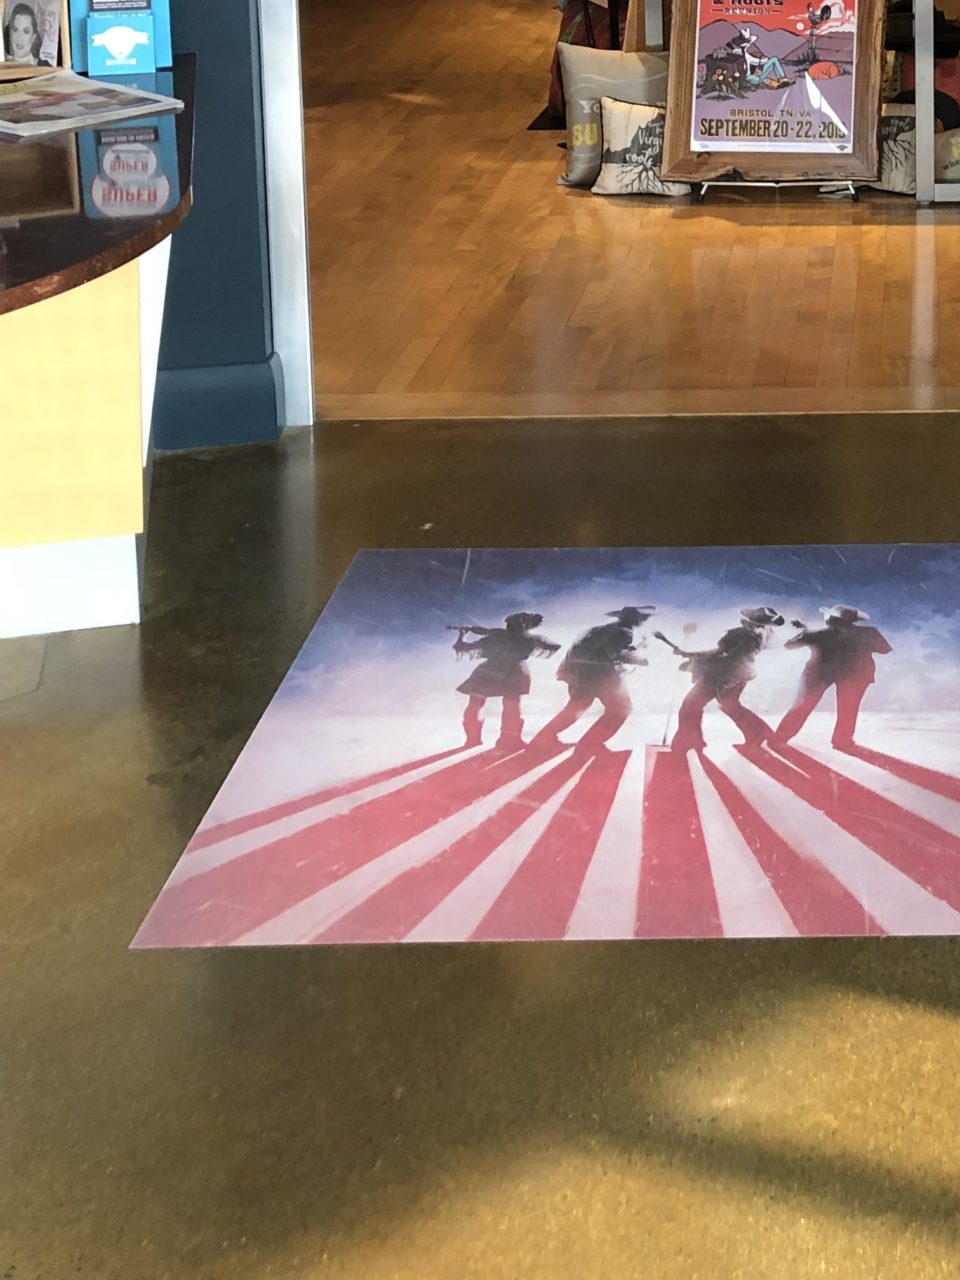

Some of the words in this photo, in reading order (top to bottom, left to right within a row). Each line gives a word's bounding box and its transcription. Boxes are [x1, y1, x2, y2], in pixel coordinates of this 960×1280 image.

[580, 100, 601, 114] Yo
[700, 118, 771, 137] SEPTEMBER
[638, 128, 663, 154] Virgi
